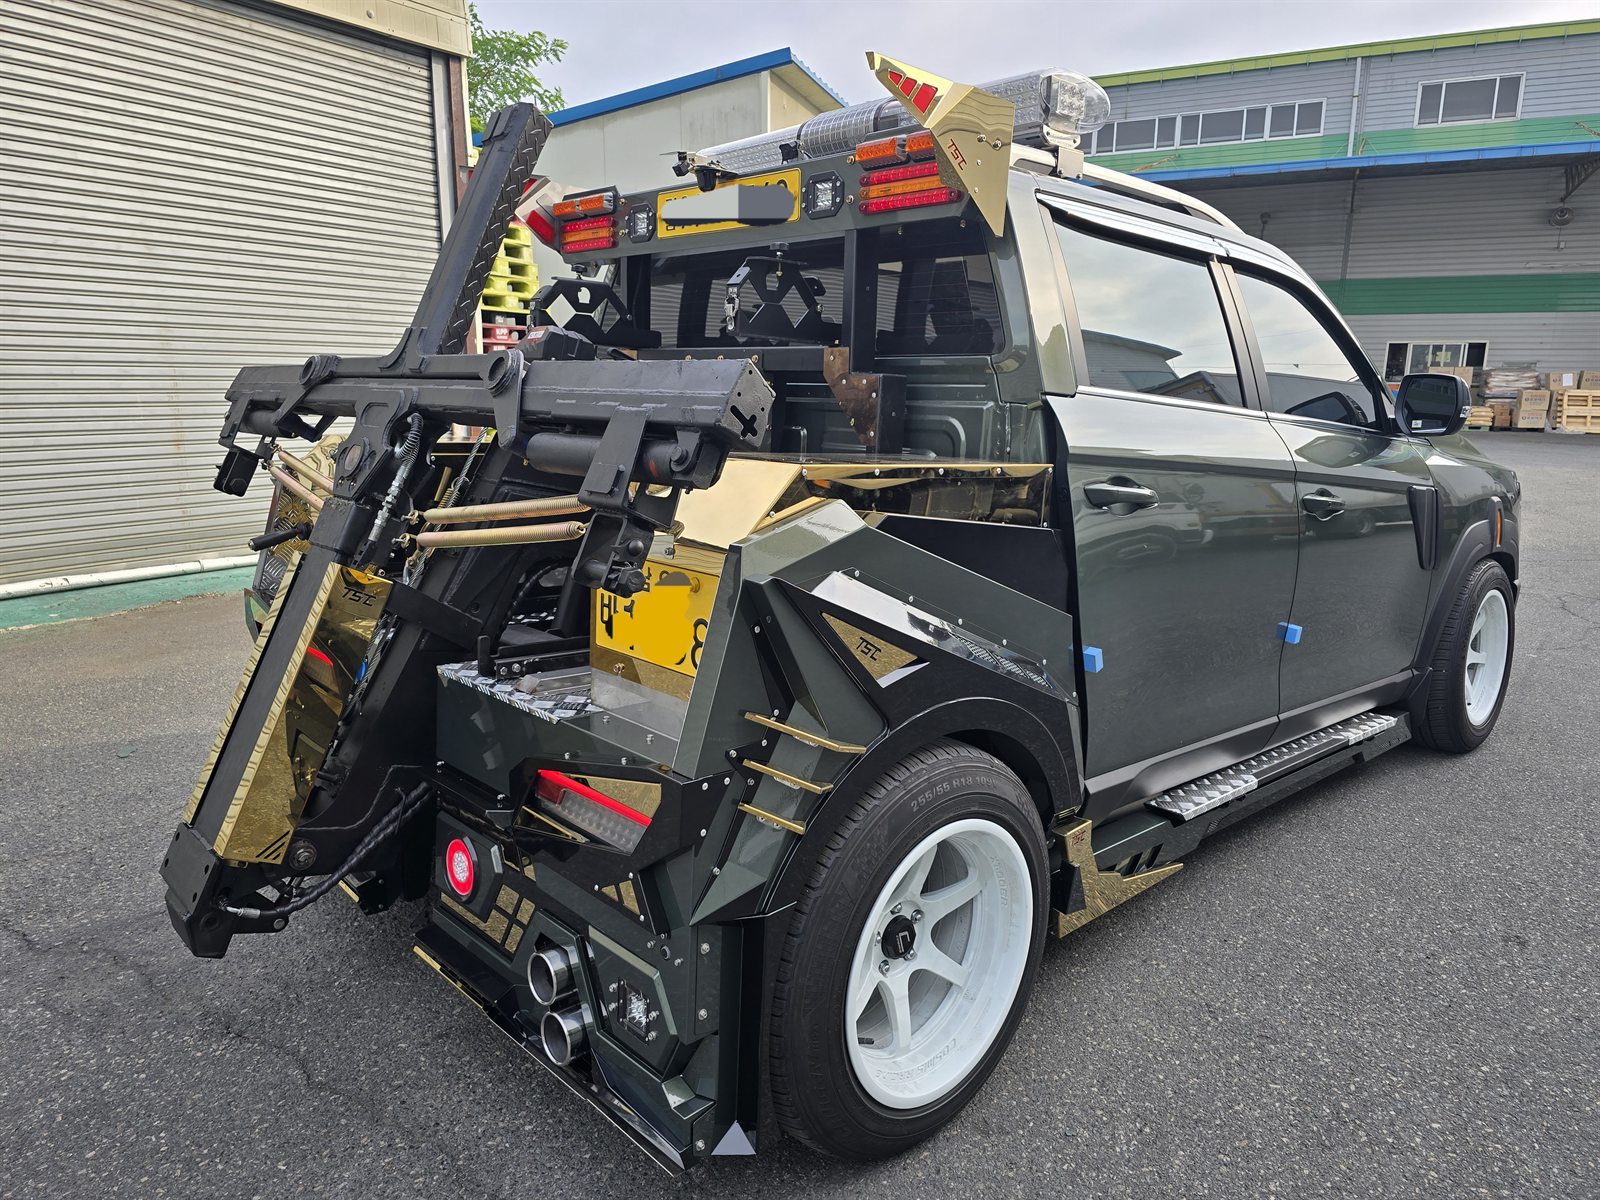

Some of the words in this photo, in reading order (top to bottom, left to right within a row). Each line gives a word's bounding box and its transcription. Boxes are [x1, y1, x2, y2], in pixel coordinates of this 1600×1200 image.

[947, 138, 967, 171] TSC
[495, 328, 508, 336] KPP
[342, 586, 377, 607] TSC
[856, 636, 882, 662] TSC
[910, 781, 951, 812] 255/55
[952, 776, 973, 789] R18
